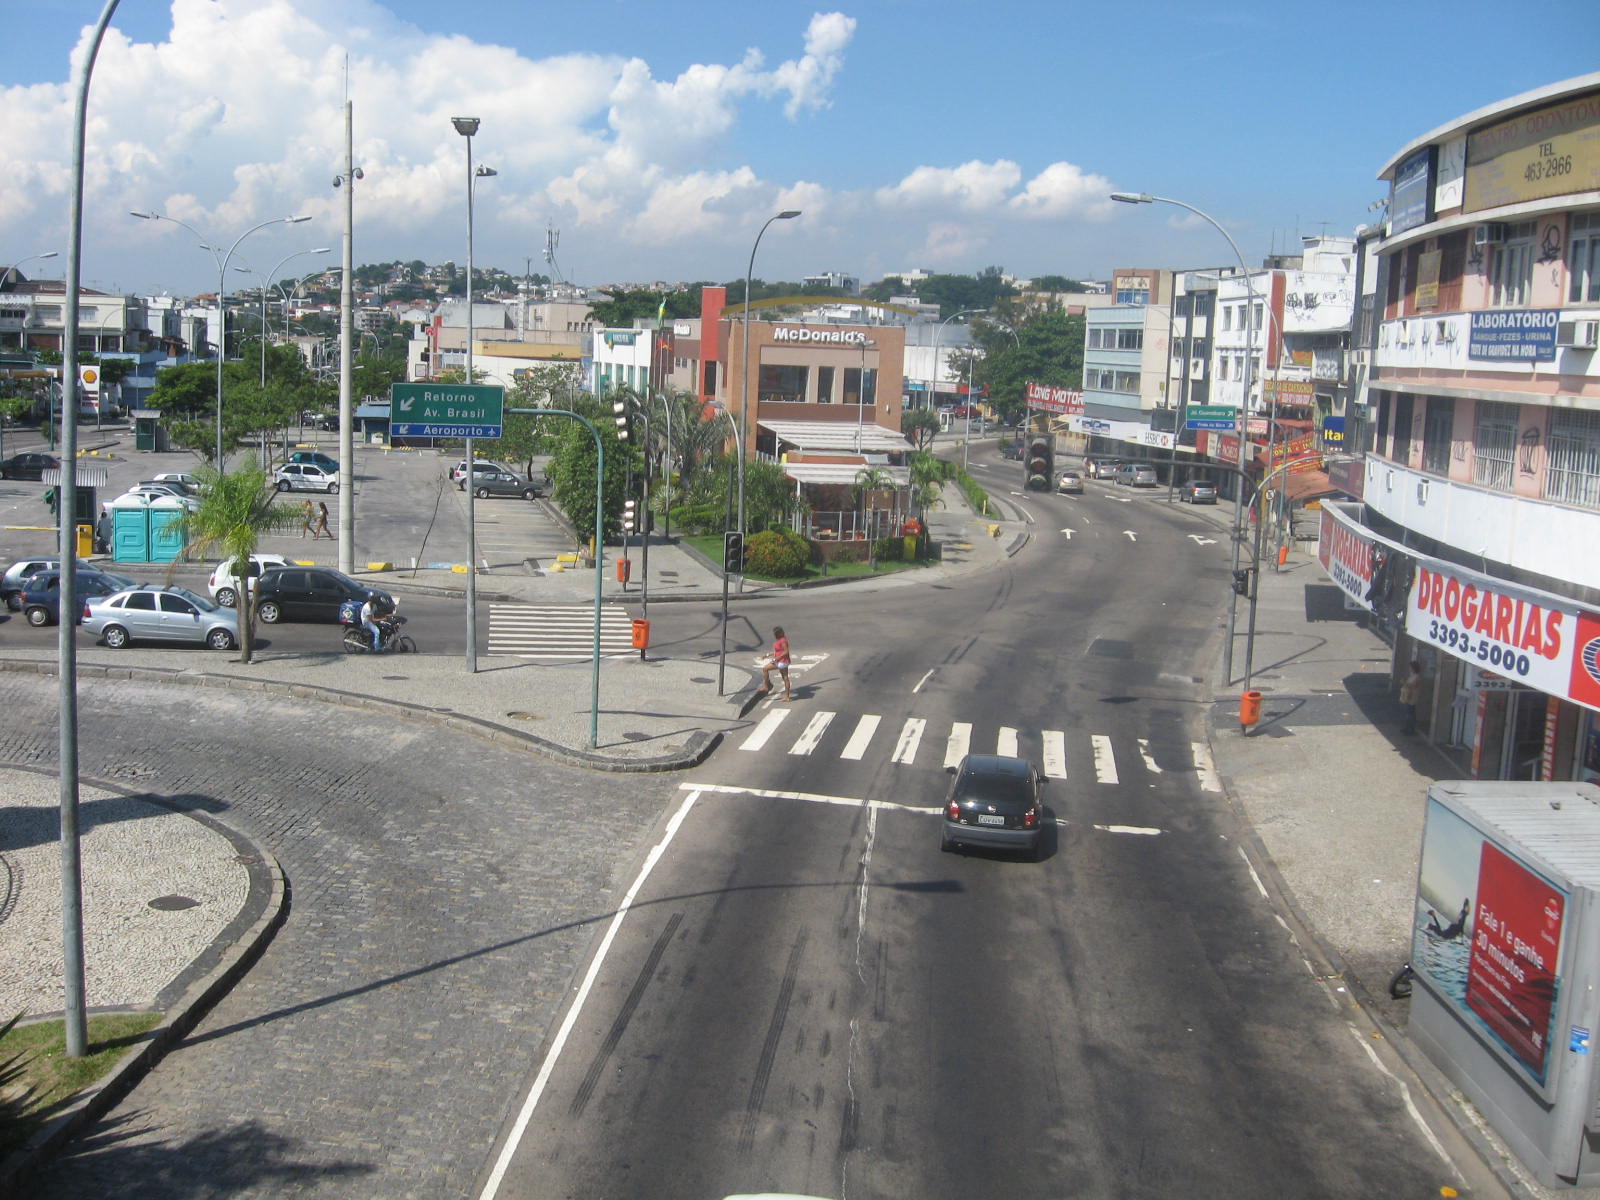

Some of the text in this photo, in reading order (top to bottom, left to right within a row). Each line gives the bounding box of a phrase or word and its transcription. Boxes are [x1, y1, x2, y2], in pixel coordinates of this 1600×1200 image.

[1539, 143, 1556, 157] TEL
[1524, 155, 1572, 182] 463-2966
[1472, 311, 1557, 328] LABORATÓRIO
[774, 327, 866, 342] McDonald's
[1525, 332, 1552, 340] URINA
[424, 391, 475, 402] Retorno
[1030, 385, 1050, 401] LONG
[424, 407, 485, 418] Av. Brasil
[423, 425, 483, 437] Aeroporto
[1145, 431, 1160, 445] HSBC
[1417, 566, 1564, 661] DROGARIAS
[1429, 619, 1530, 676] 3393-5000
[1479, 903, 1498, 932] Fale
[1506, 930, 1514, 944] e
[1513, 936, 1544, 970] ganhe
[1476, 929, 1489, 951] 30
[1488, 943, 1526, 983] minutos
